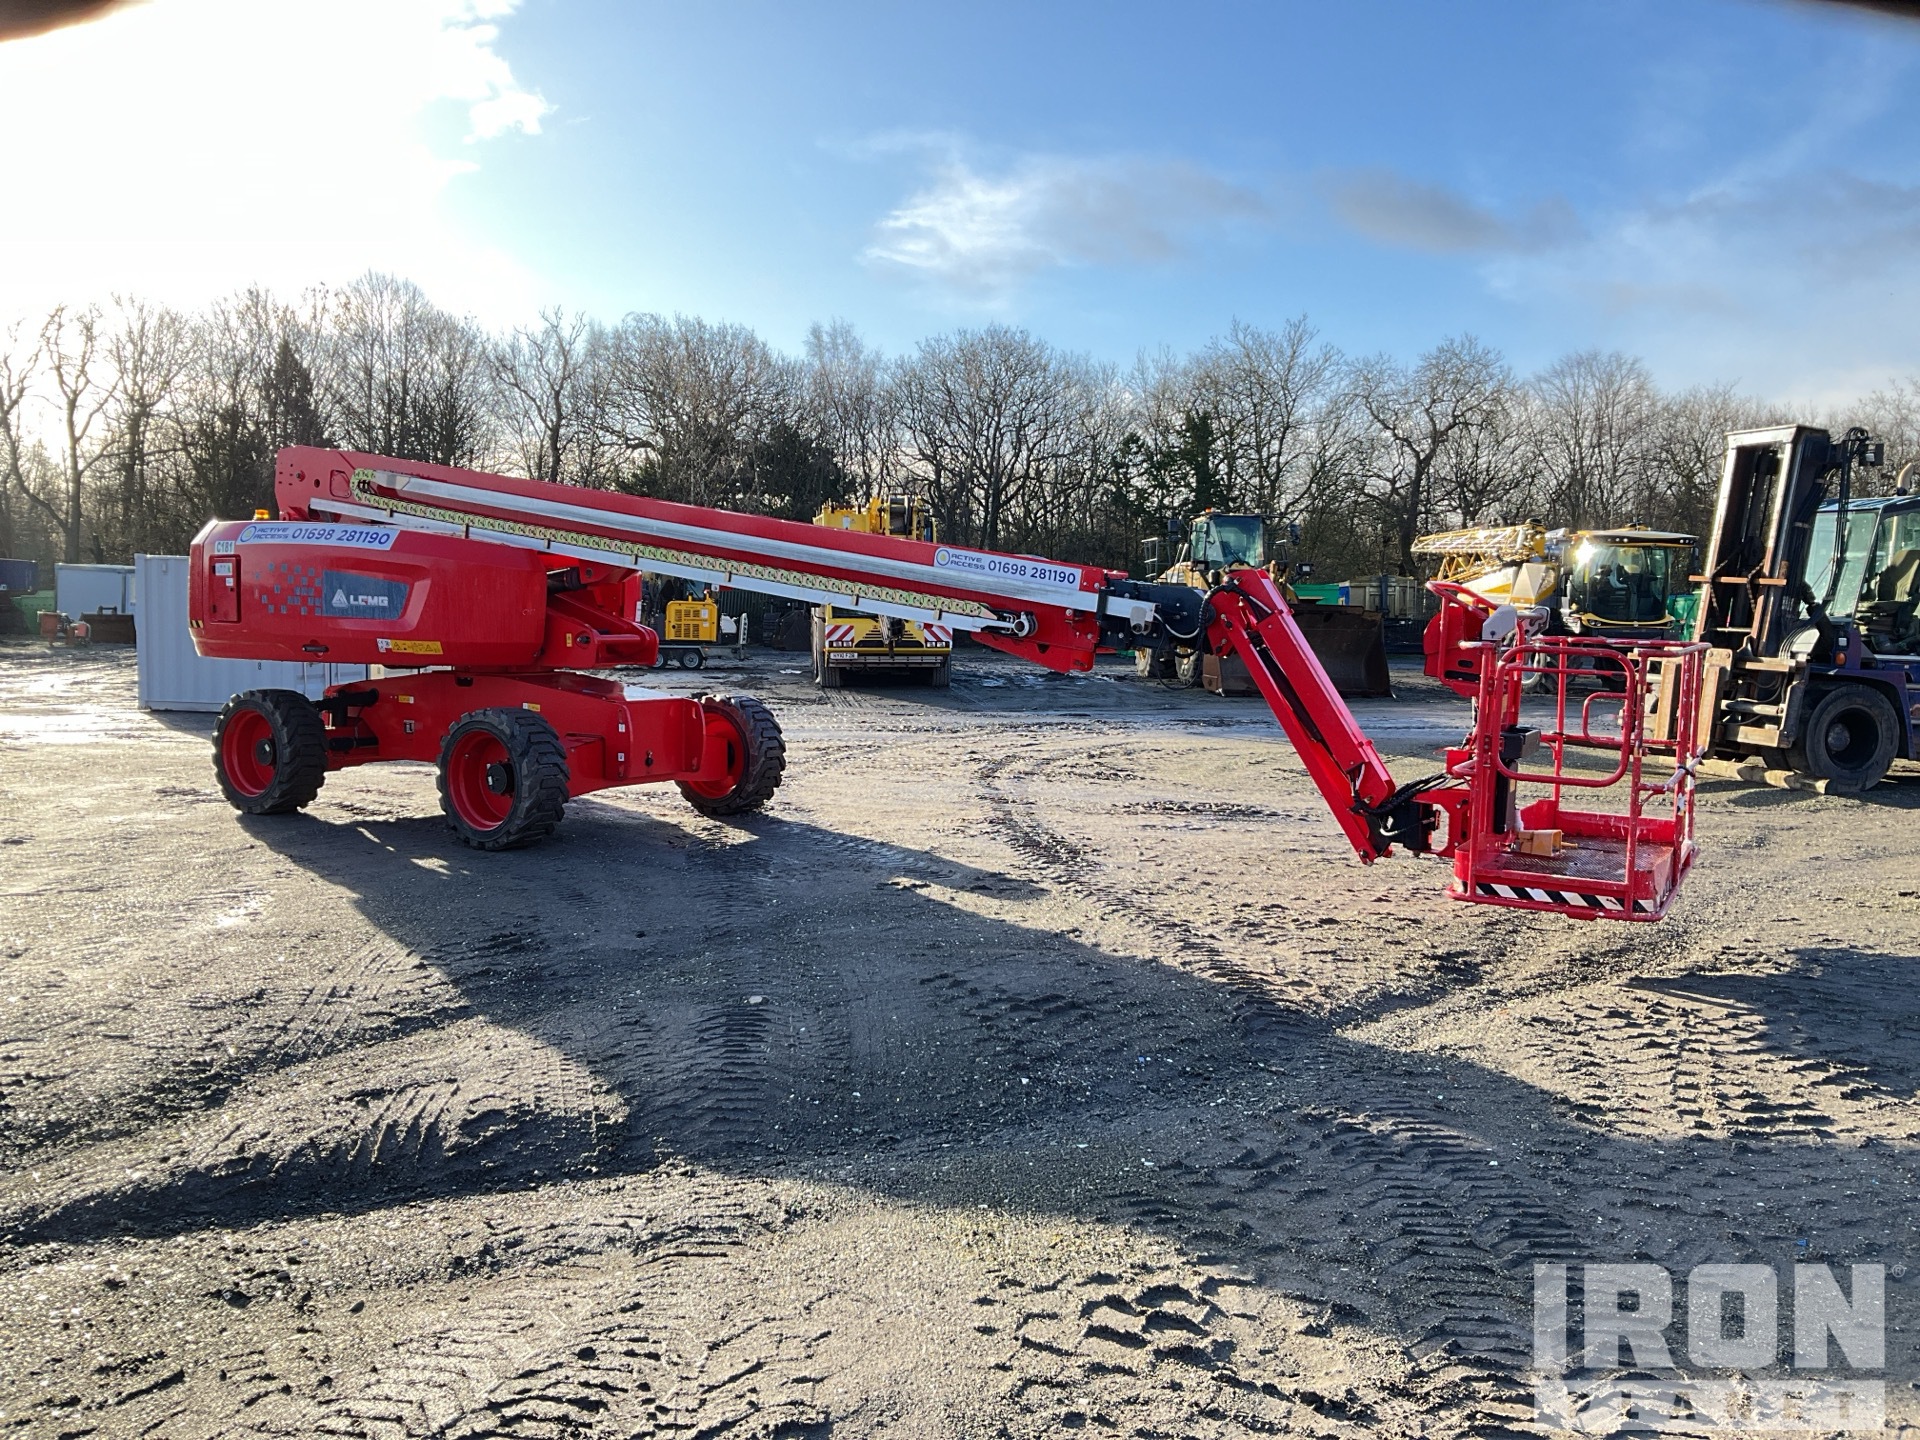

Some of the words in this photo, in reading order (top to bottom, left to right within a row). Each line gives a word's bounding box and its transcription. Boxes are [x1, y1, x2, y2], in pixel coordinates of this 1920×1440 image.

[292, 528, 335, 540] 01698
[336, 529, 391, 545] 281190
[216, 541, 233, 553] C181
[951, 553, 983, 563] ACTIVE
[950, 559, 985, 570] ACCESS
[988, 560, 1027, 576] 01698
[1030, 566, 1076, 584] 281190
